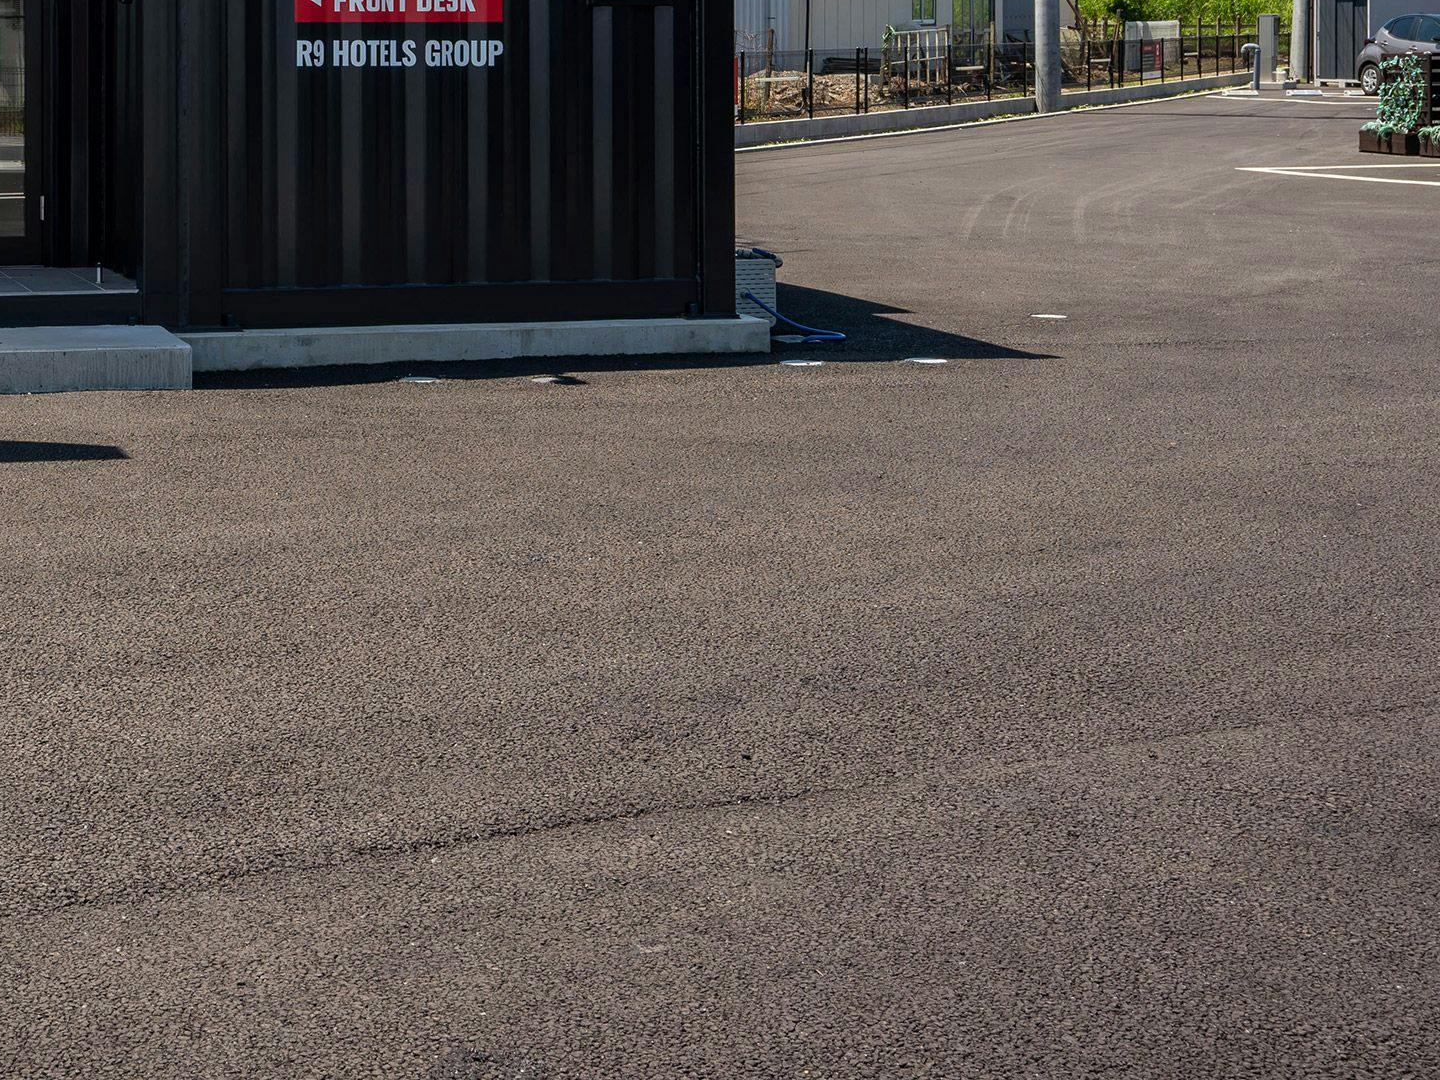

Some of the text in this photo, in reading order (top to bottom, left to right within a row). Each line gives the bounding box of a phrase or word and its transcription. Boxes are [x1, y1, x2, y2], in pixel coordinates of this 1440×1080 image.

[296, 40, 504, 67] R9 HOTELS GROUP
